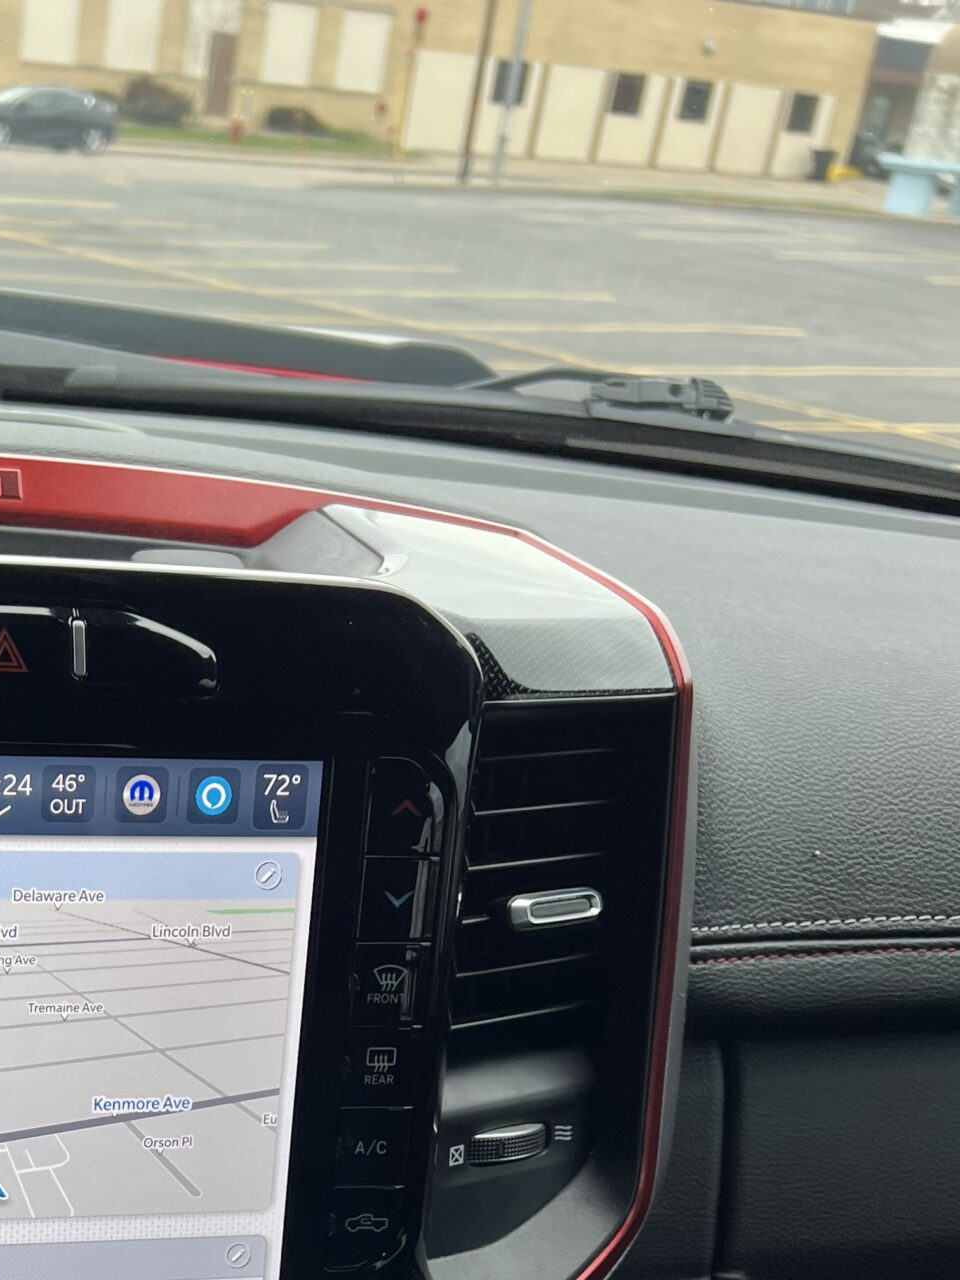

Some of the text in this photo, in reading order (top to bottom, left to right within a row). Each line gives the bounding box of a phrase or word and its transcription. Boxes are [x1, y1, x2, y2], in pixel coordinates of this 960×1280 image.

[50, 799, 86, 815] OUT
[13, 889, 104, 903] Delaware Ave
[152, 924, 231, 938] Lincoln Blvd
[12, 952, 36, 966] Ave
[367, 993, 404, 1004] FRONT
[28, 1000, 104, 1014] Tremaine Ave
[364, 1074, 394, 1085] REAR
[93, 1096, 191, 1112] Kenmore Ave
[263, 1113, 278, 1126] Eu
[143, 1136, 176, 1149] Orson
[354, 1140, 388, 1155] A/C
